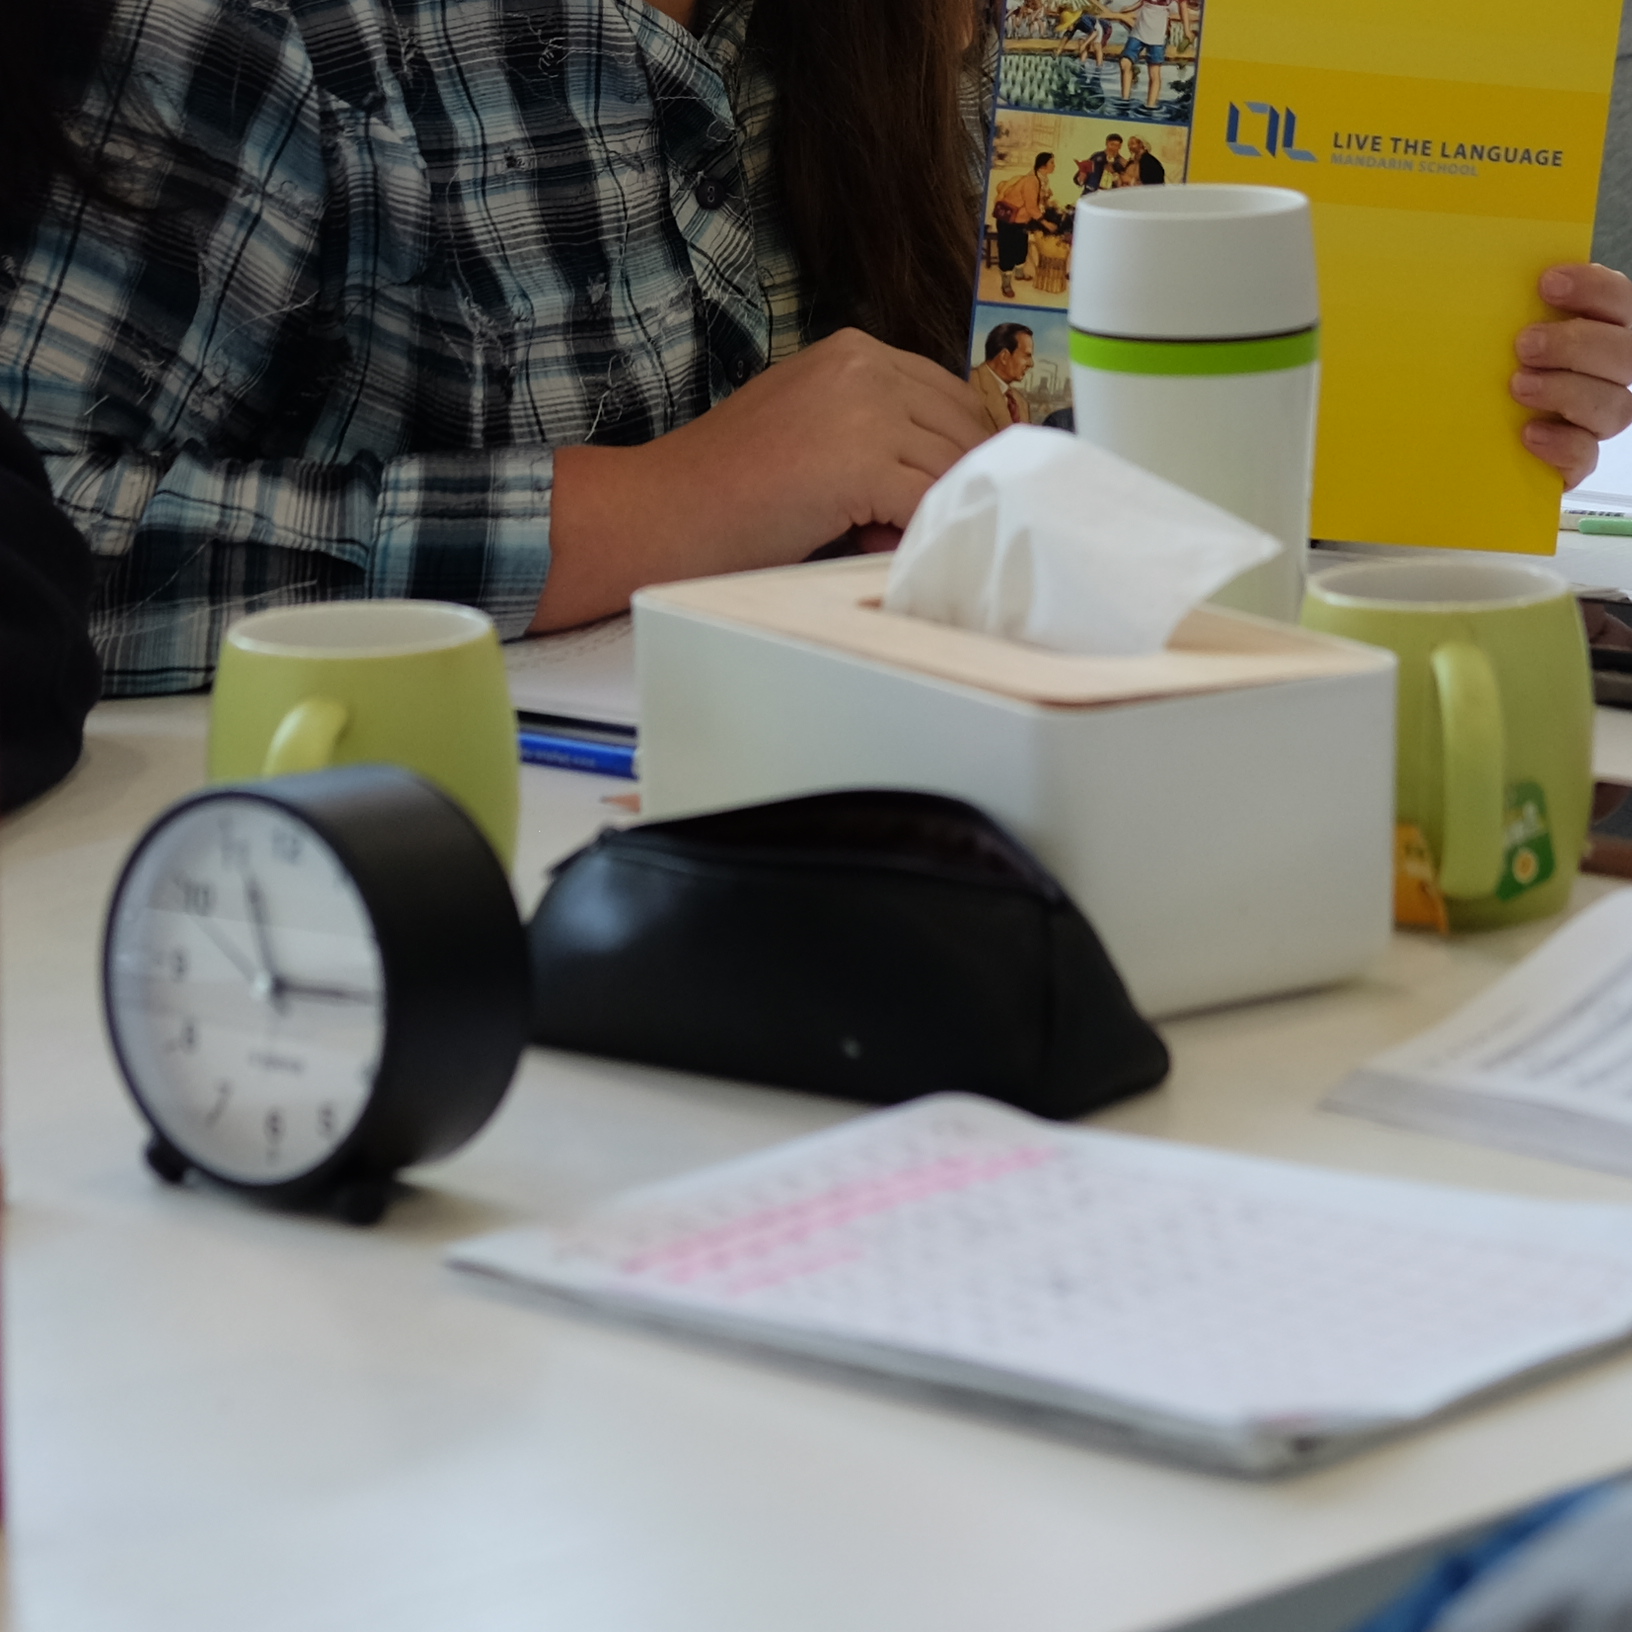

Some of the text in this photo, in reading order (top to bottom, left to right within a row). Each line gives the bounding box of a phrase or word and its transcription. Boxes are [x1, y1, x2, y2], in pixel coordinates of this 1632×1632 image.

[1332, 131, 1564, 167] LIVE THE LANGUAGE
[1330, 152, 1479, 177] MANDARIN SCHOOL
